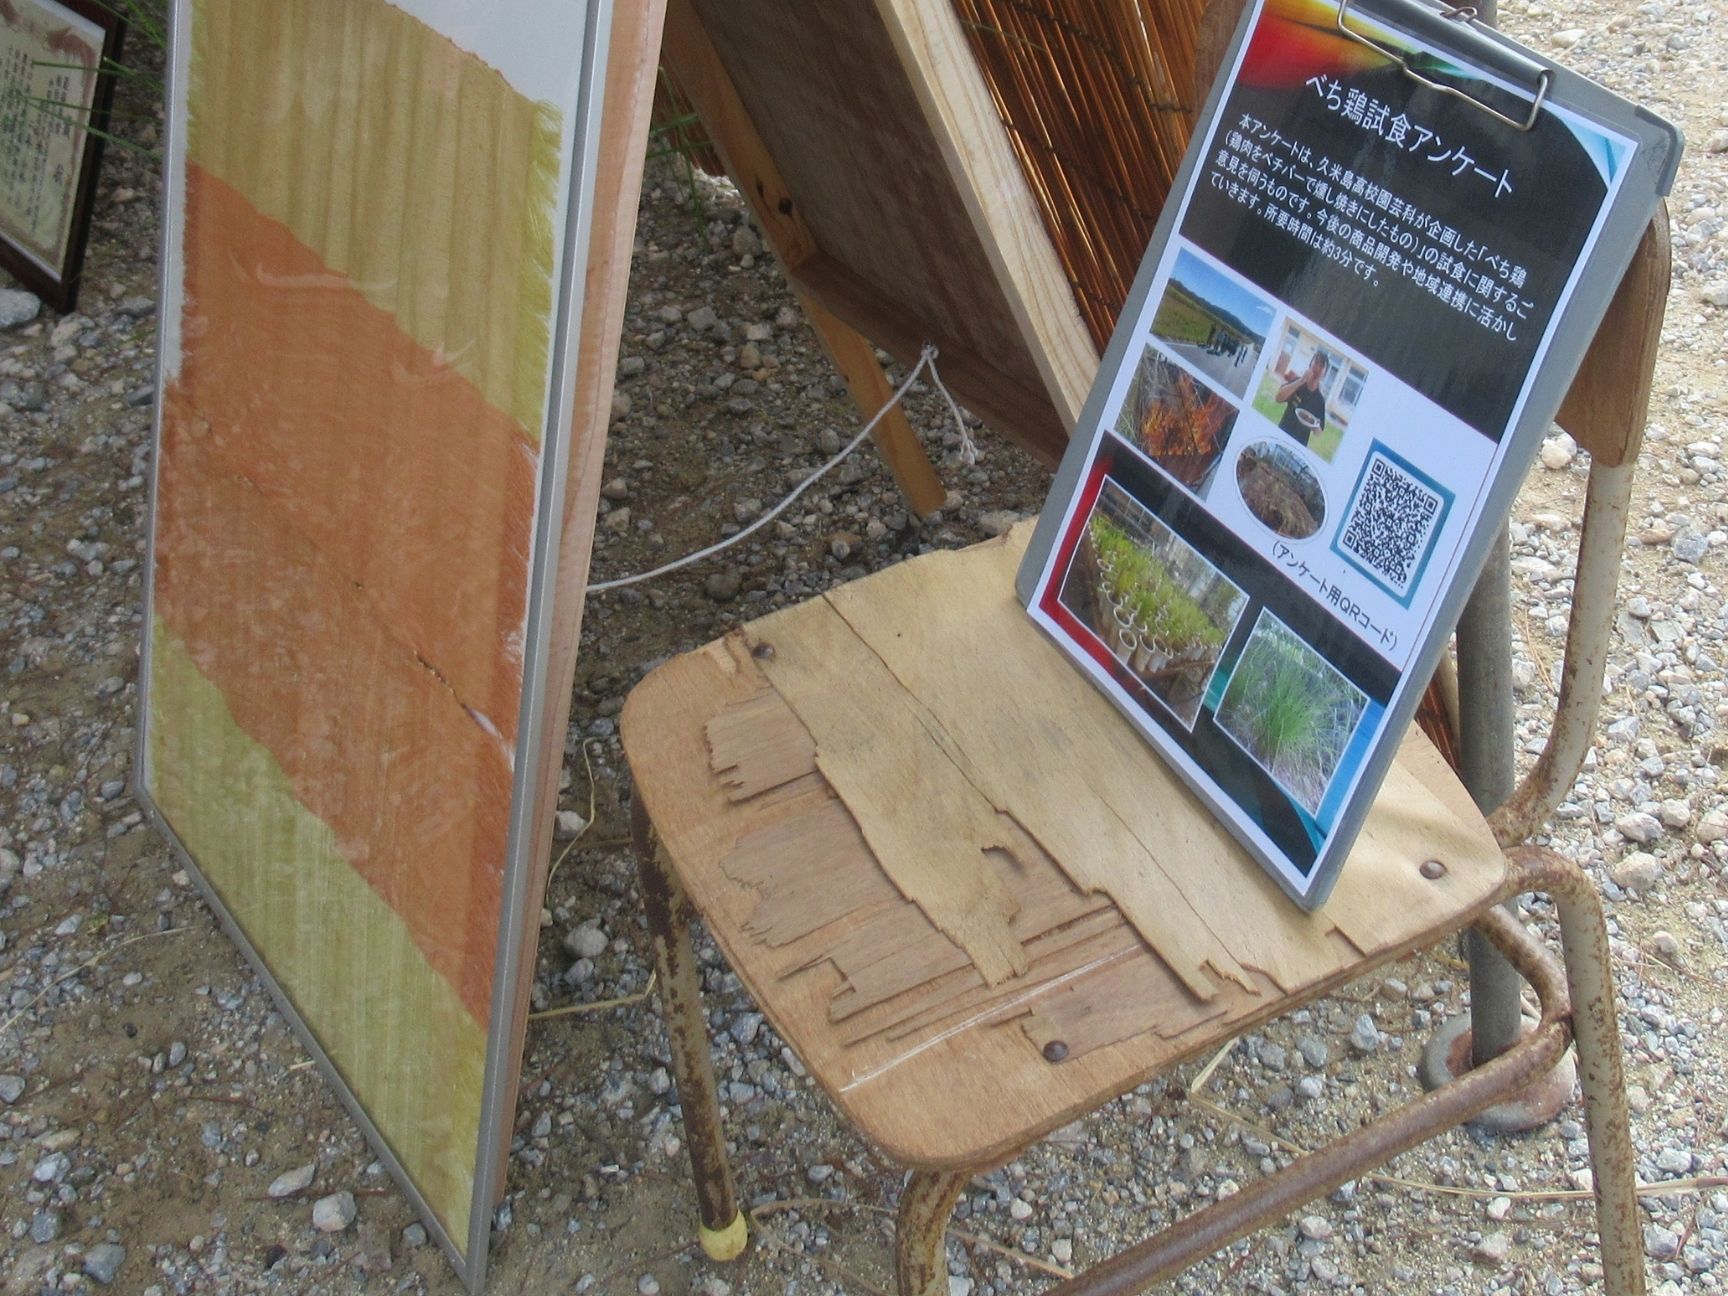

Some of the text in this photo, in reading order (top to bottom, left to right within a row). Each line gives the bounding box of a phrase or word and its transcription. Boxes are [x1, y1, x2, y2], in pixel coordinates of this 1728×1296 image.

[1305, 73, 1514, 199] べち鶏試食アンケート
[1210, 170, 1380, 287] ていきます。所要時間は約3分です。
[1215, 149, 1517, 342] 意見を伺うものです。今後の商品開発や地域連携に活かし
[1238, 113, 1528, 290] 本アンケートは、久米島高校園芸科が企画した「べち鶏
[1272, 540, 1398, 652] (アンケート用QRコード)
